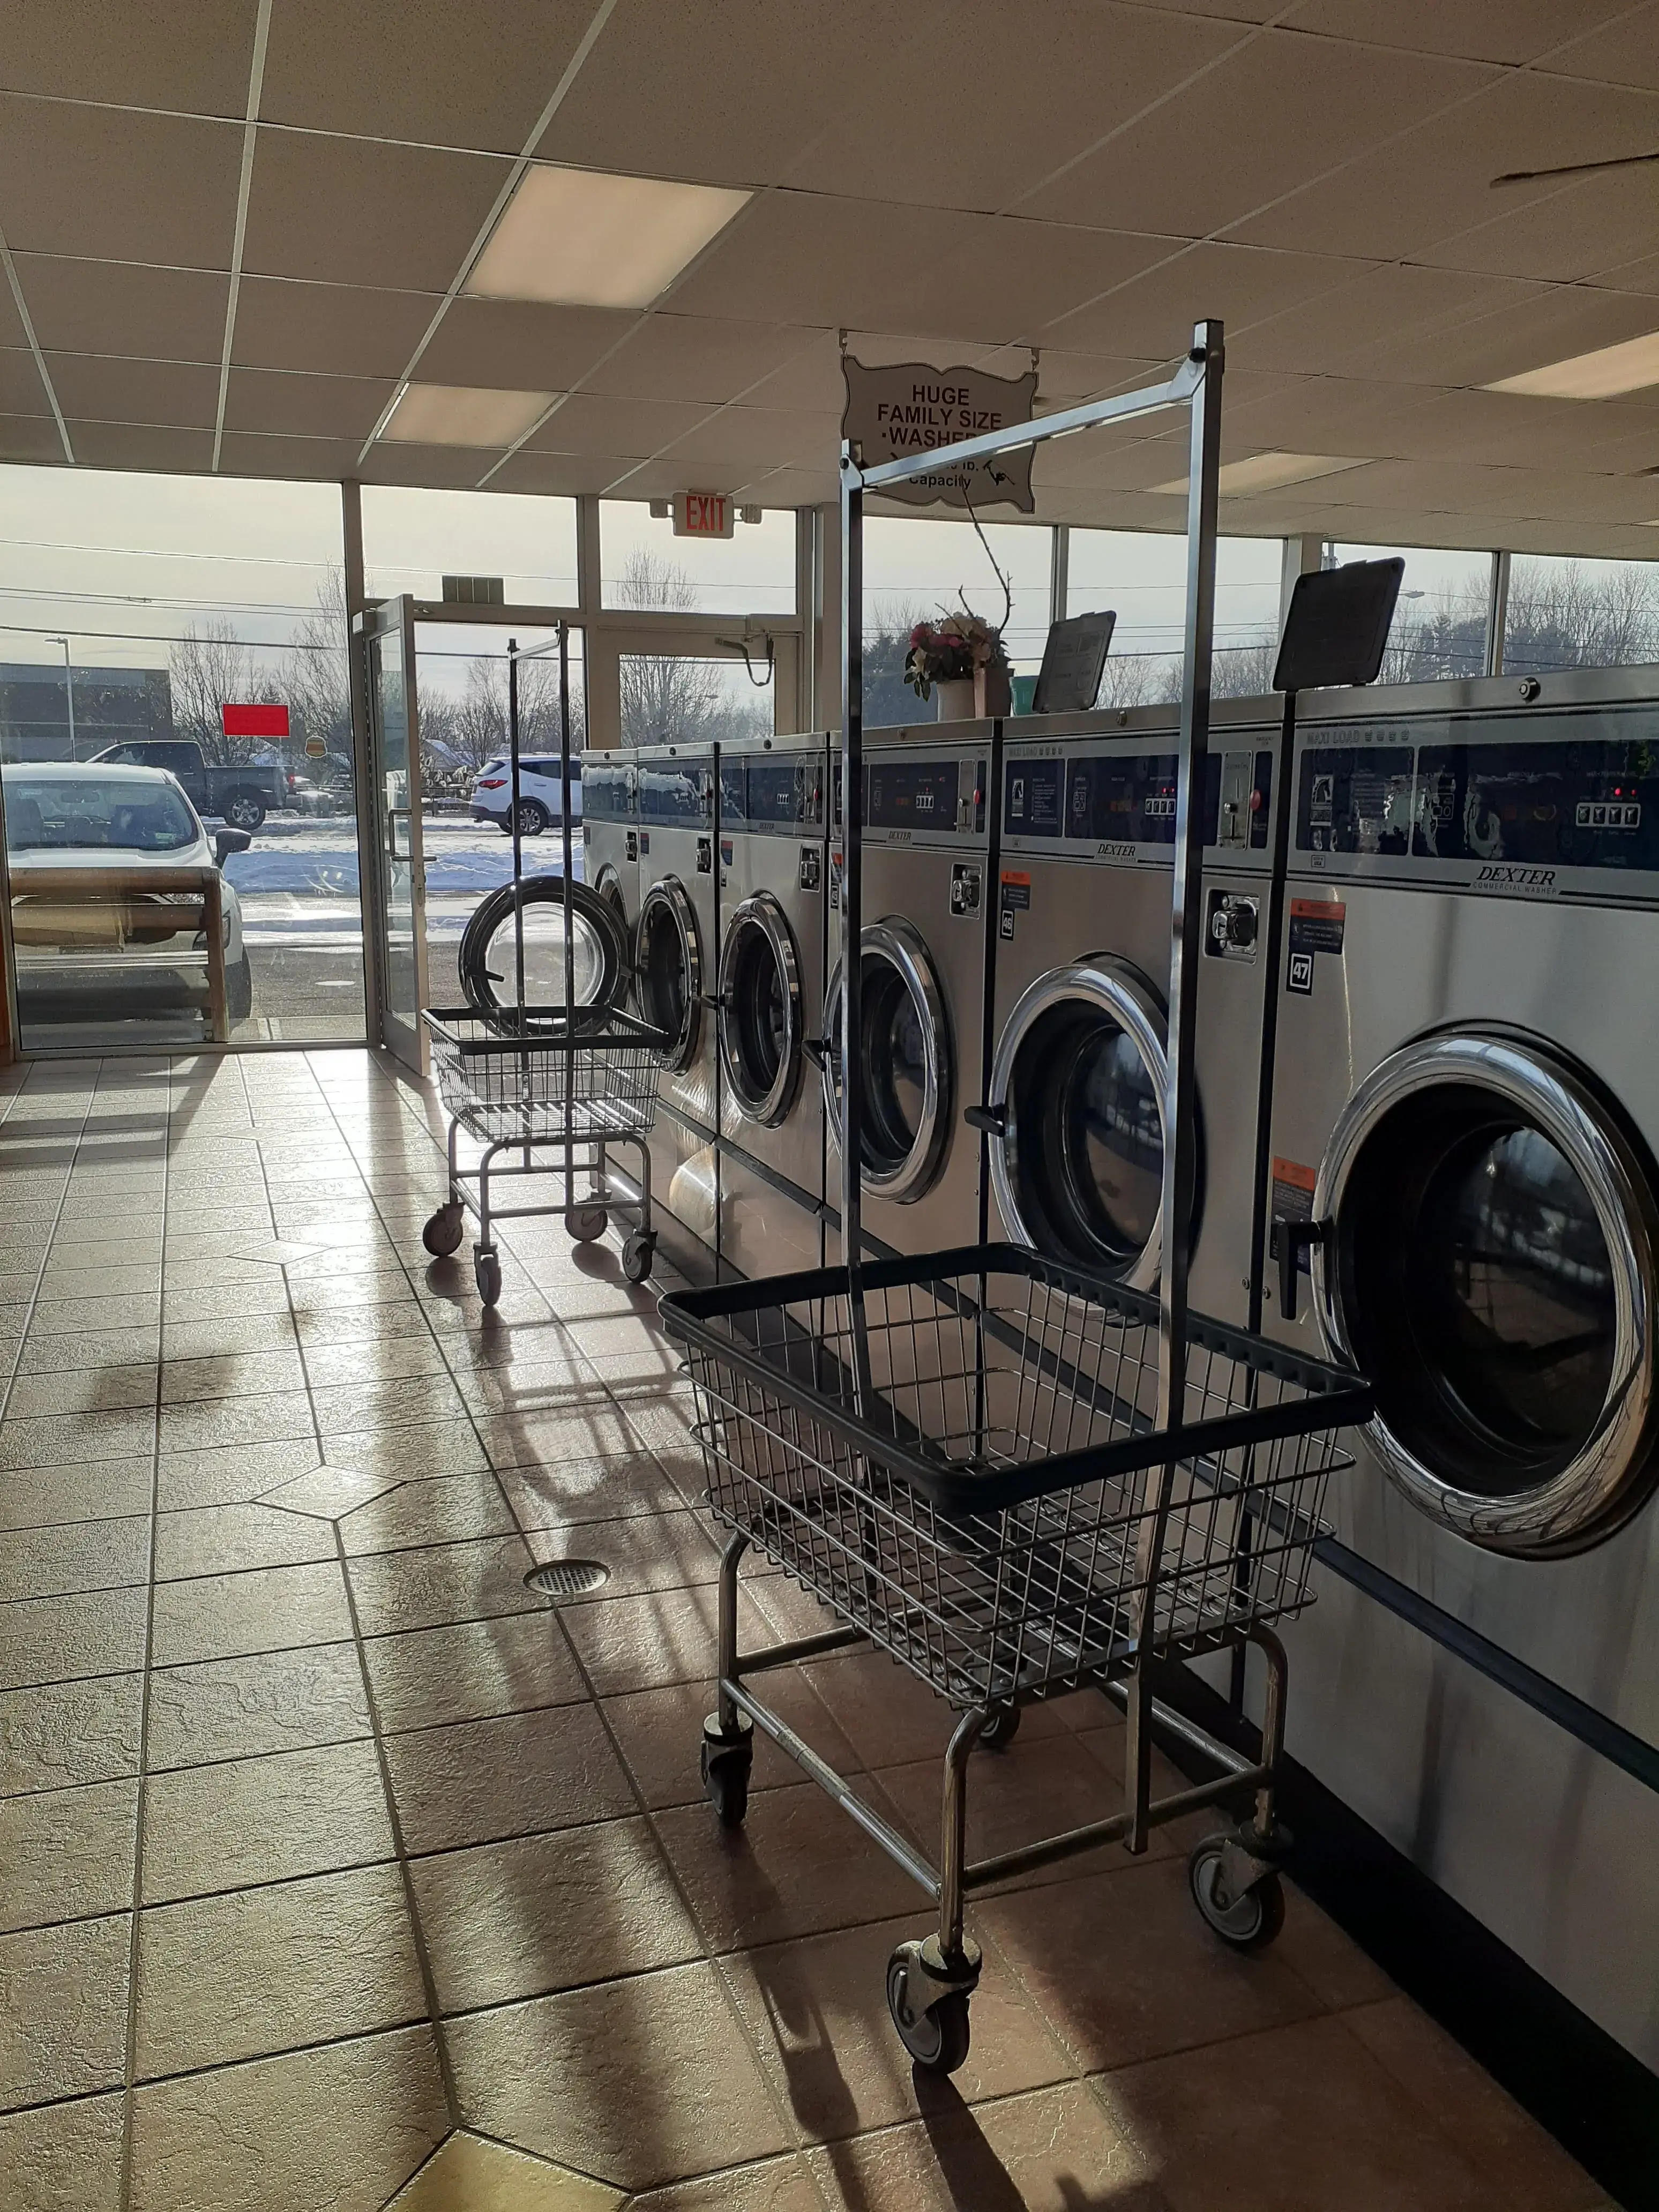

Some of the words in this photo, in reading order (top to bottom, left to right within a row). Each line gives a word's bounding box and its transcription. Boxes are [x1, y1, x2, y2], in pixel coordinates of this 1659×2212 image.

[912, 384, 969, 406] HUGE
[877, 403, 953, 426] FAMILY
[959, 410, 1002, 430] SIZE
[686, 495, 726, 532] EXIT
[888, 831, 911, 841] DEXTER
[1097, 843, 1136, 856] DEXTER
[1476, 866, 1556, 886] DEXTER
[1473, 881, 1522, 892] COMMERCIAL
[1525, 887, 1557, 895] WASHER
[1003, 917, 1012, 930] 46
[1292, 962, 1309, 980] 47
